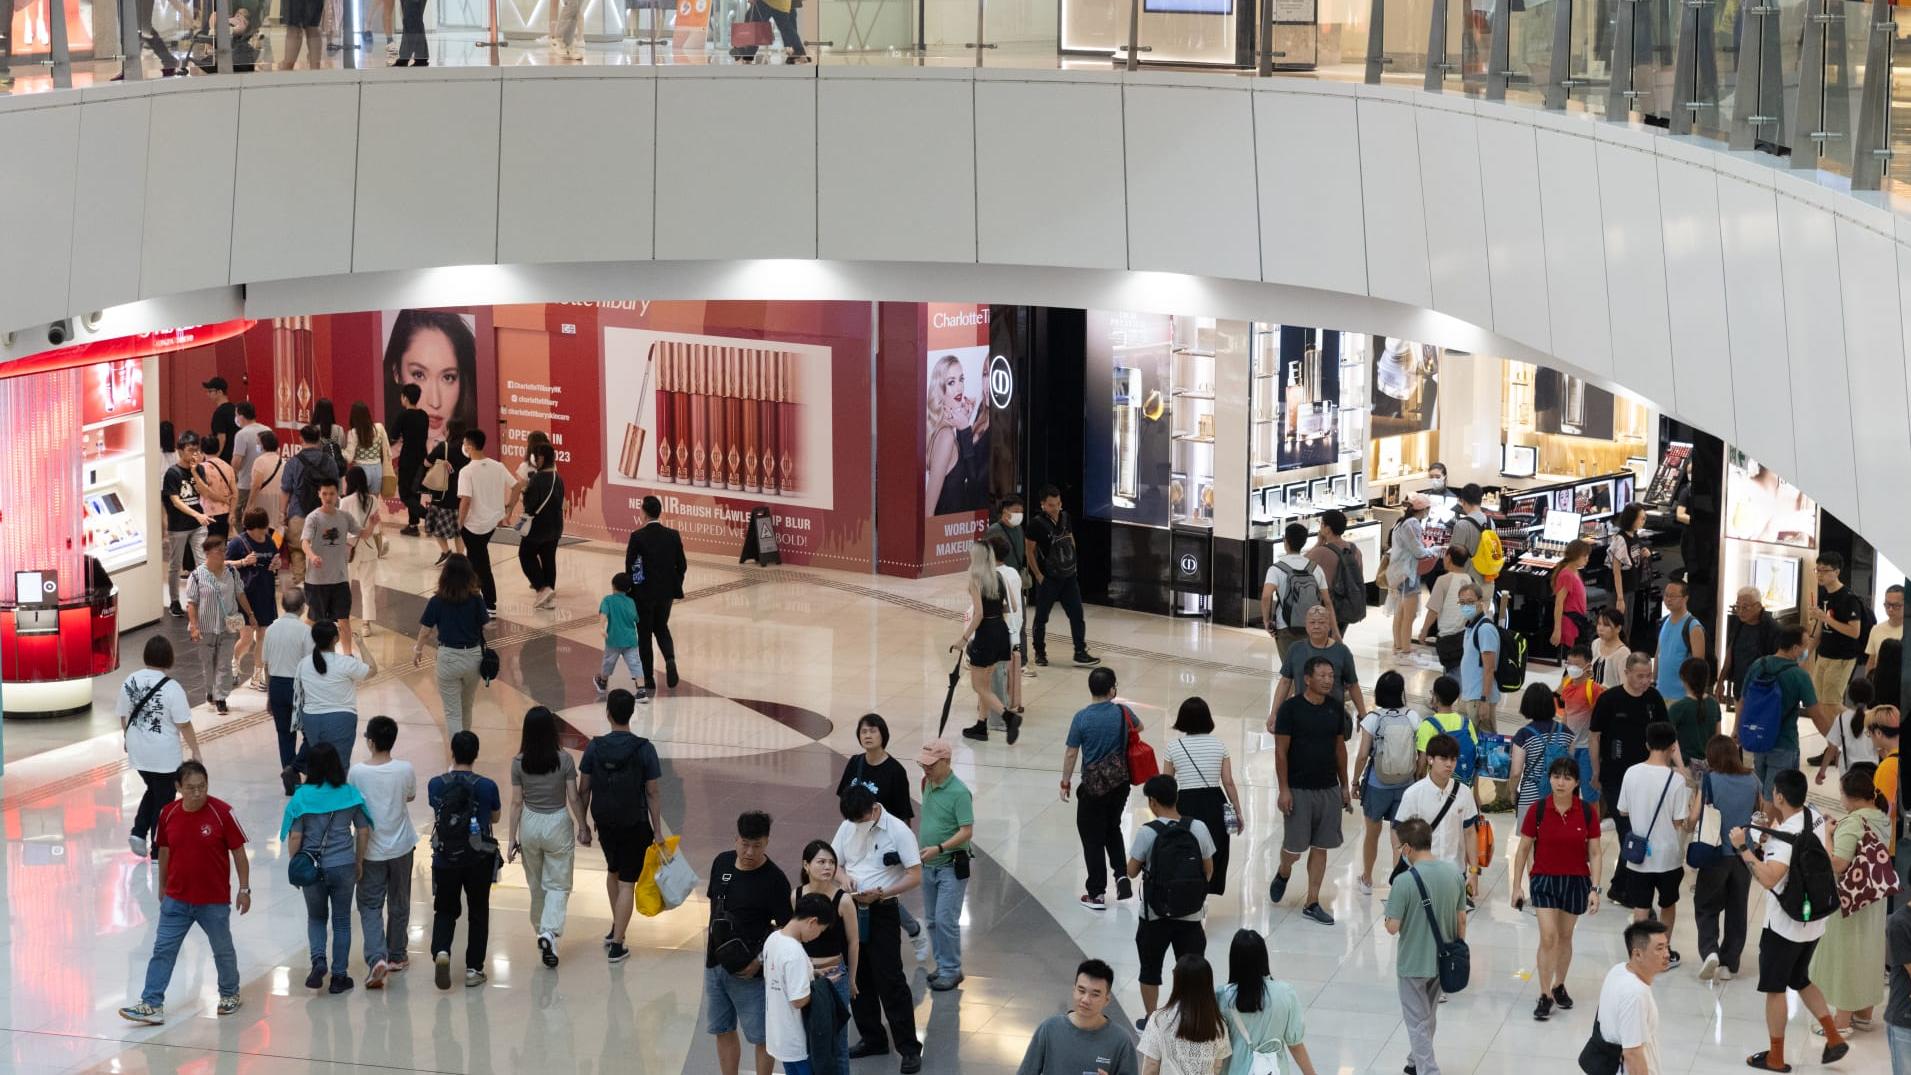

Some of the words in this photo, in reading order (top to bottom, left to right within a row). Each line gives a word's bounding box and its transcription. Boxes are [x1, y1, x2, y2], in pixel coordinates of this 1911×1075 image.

[552, 433, 563, 445] IN
[553, 449, 571, 463] 023
[714, 507, 751, 523] FLAWLE
[772, 514, 782, 527] IP
[785, 516, 811, 531] BLUR
[944, 519, 985, 537] WORLD'S
[775, 532, 808, 547] BOLD!
